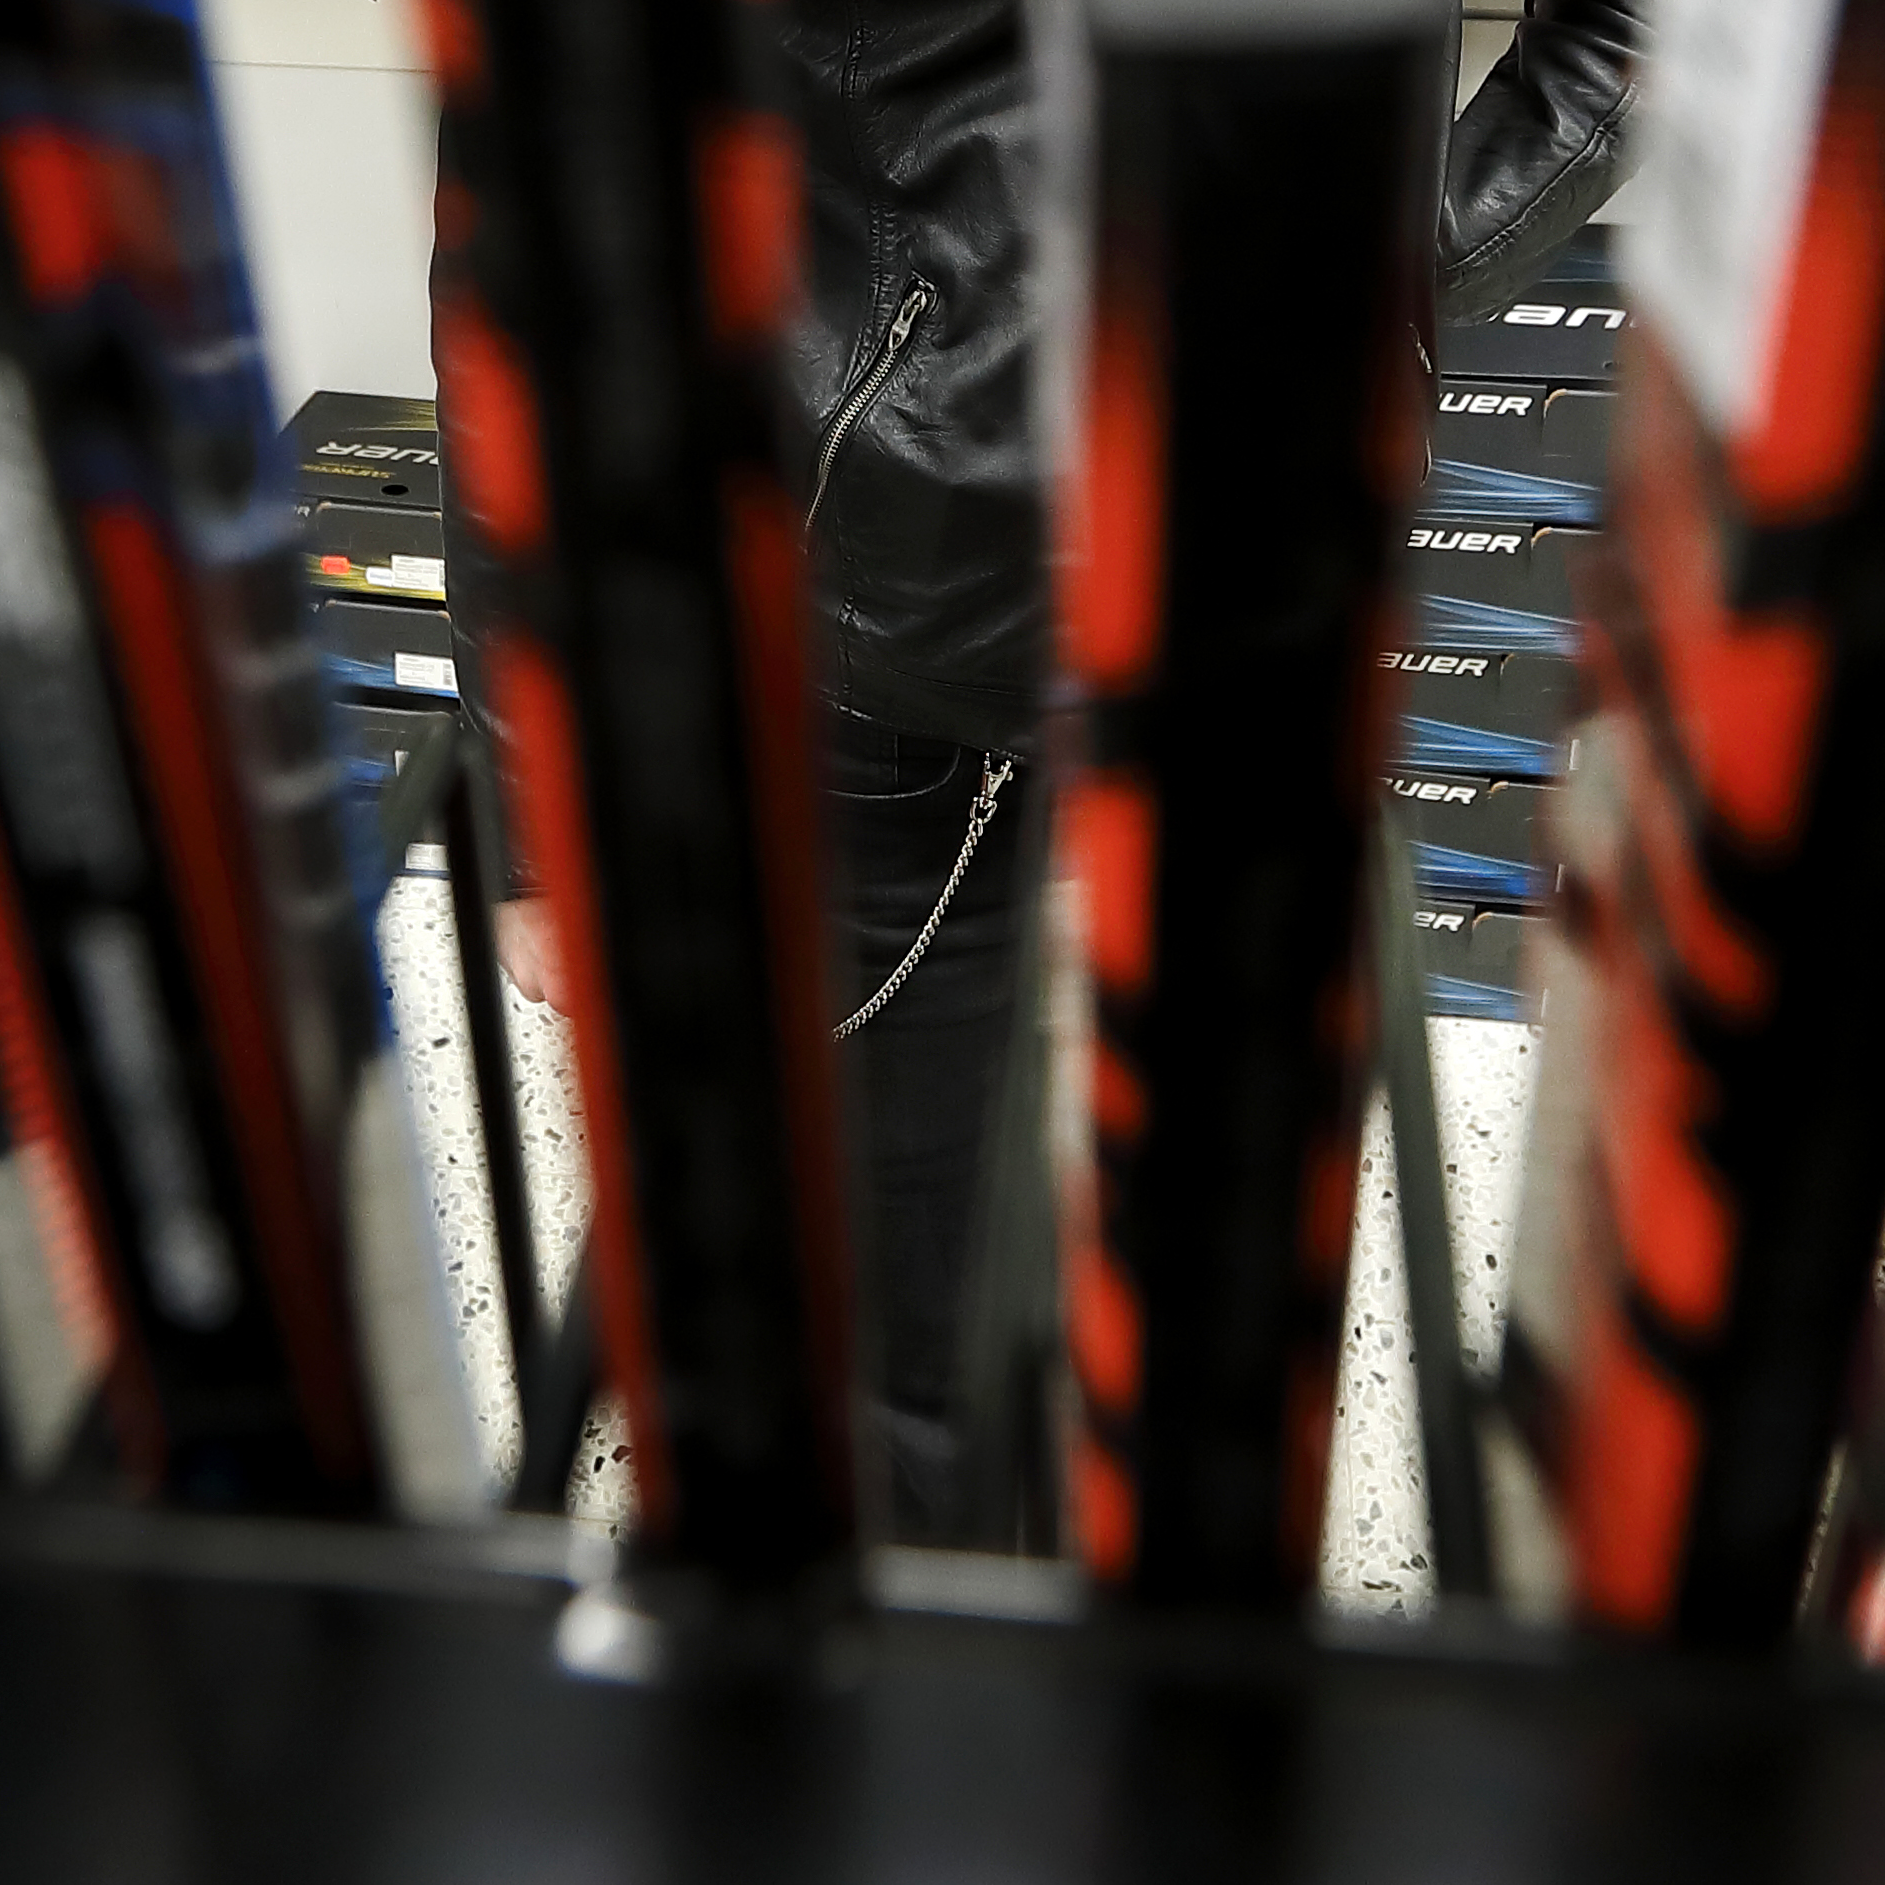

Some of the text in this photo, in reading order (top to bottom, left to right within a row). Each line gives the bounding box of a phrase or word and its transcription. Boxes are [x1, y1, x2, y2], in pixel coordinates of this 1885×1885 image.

[1438, 392, 1533, 416] UER
[316, 441, 439, 466] UER
[1406, 528, 1522, 554] AUER
[1377, 652, 1490, 678] AUER
[1390, 777, 1478, 805] UER
